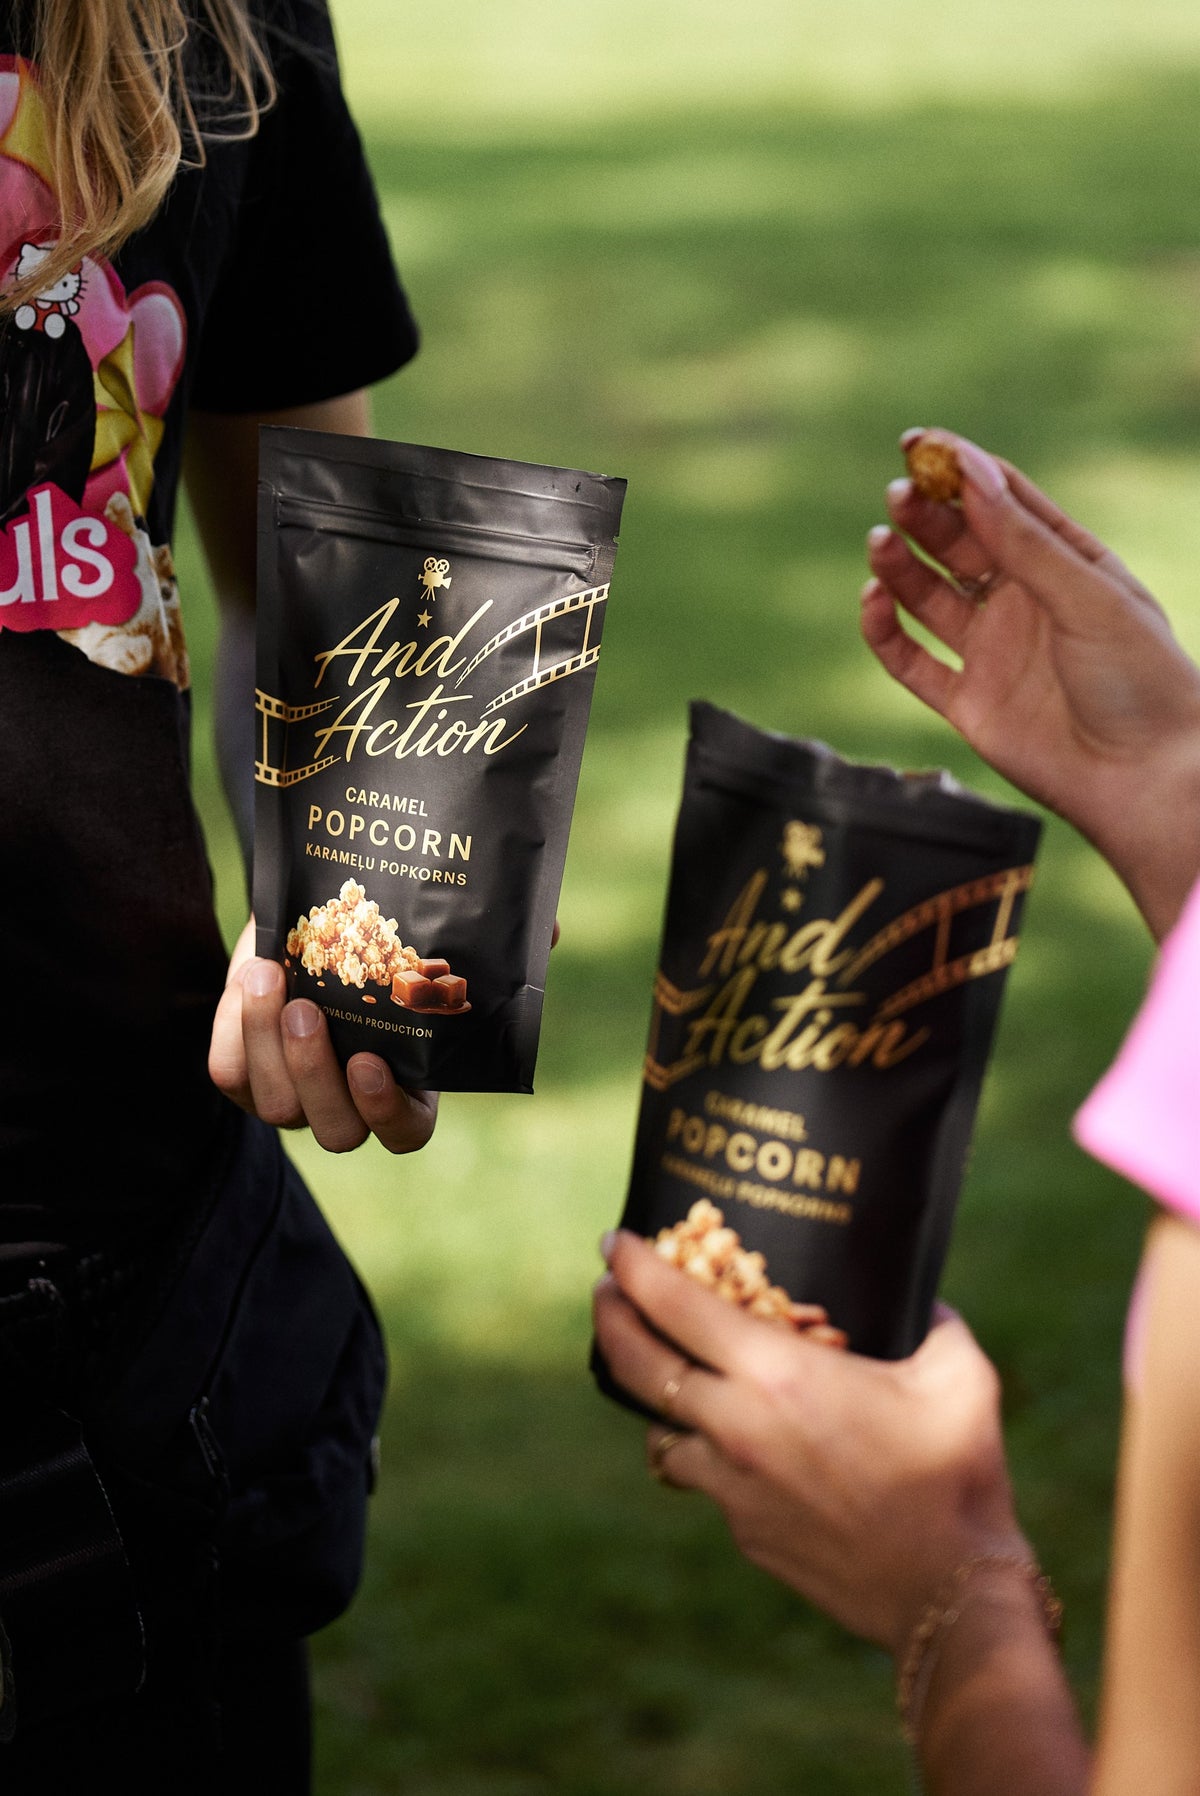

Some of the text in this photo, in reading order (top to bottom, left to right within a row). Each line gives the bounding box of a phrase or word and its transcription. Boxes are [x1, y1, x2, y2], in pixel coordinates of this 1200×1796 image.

[314, 597, 494, 688] And
[314, 677, 528, 762] Action
[307, 804, 473, 861] POPCORN
[345, 786, 429, 817] CARAMEL
[305, 843, 468, 886] KARAMEĻU POPKORNS
[698, 867, 885, 978] And
[320, 1005, 433, 1039] OVALOVA PRODUCTION
[683, 966, 932, 1073] Action
[667, 1107, 862, 1196] POPCORN
